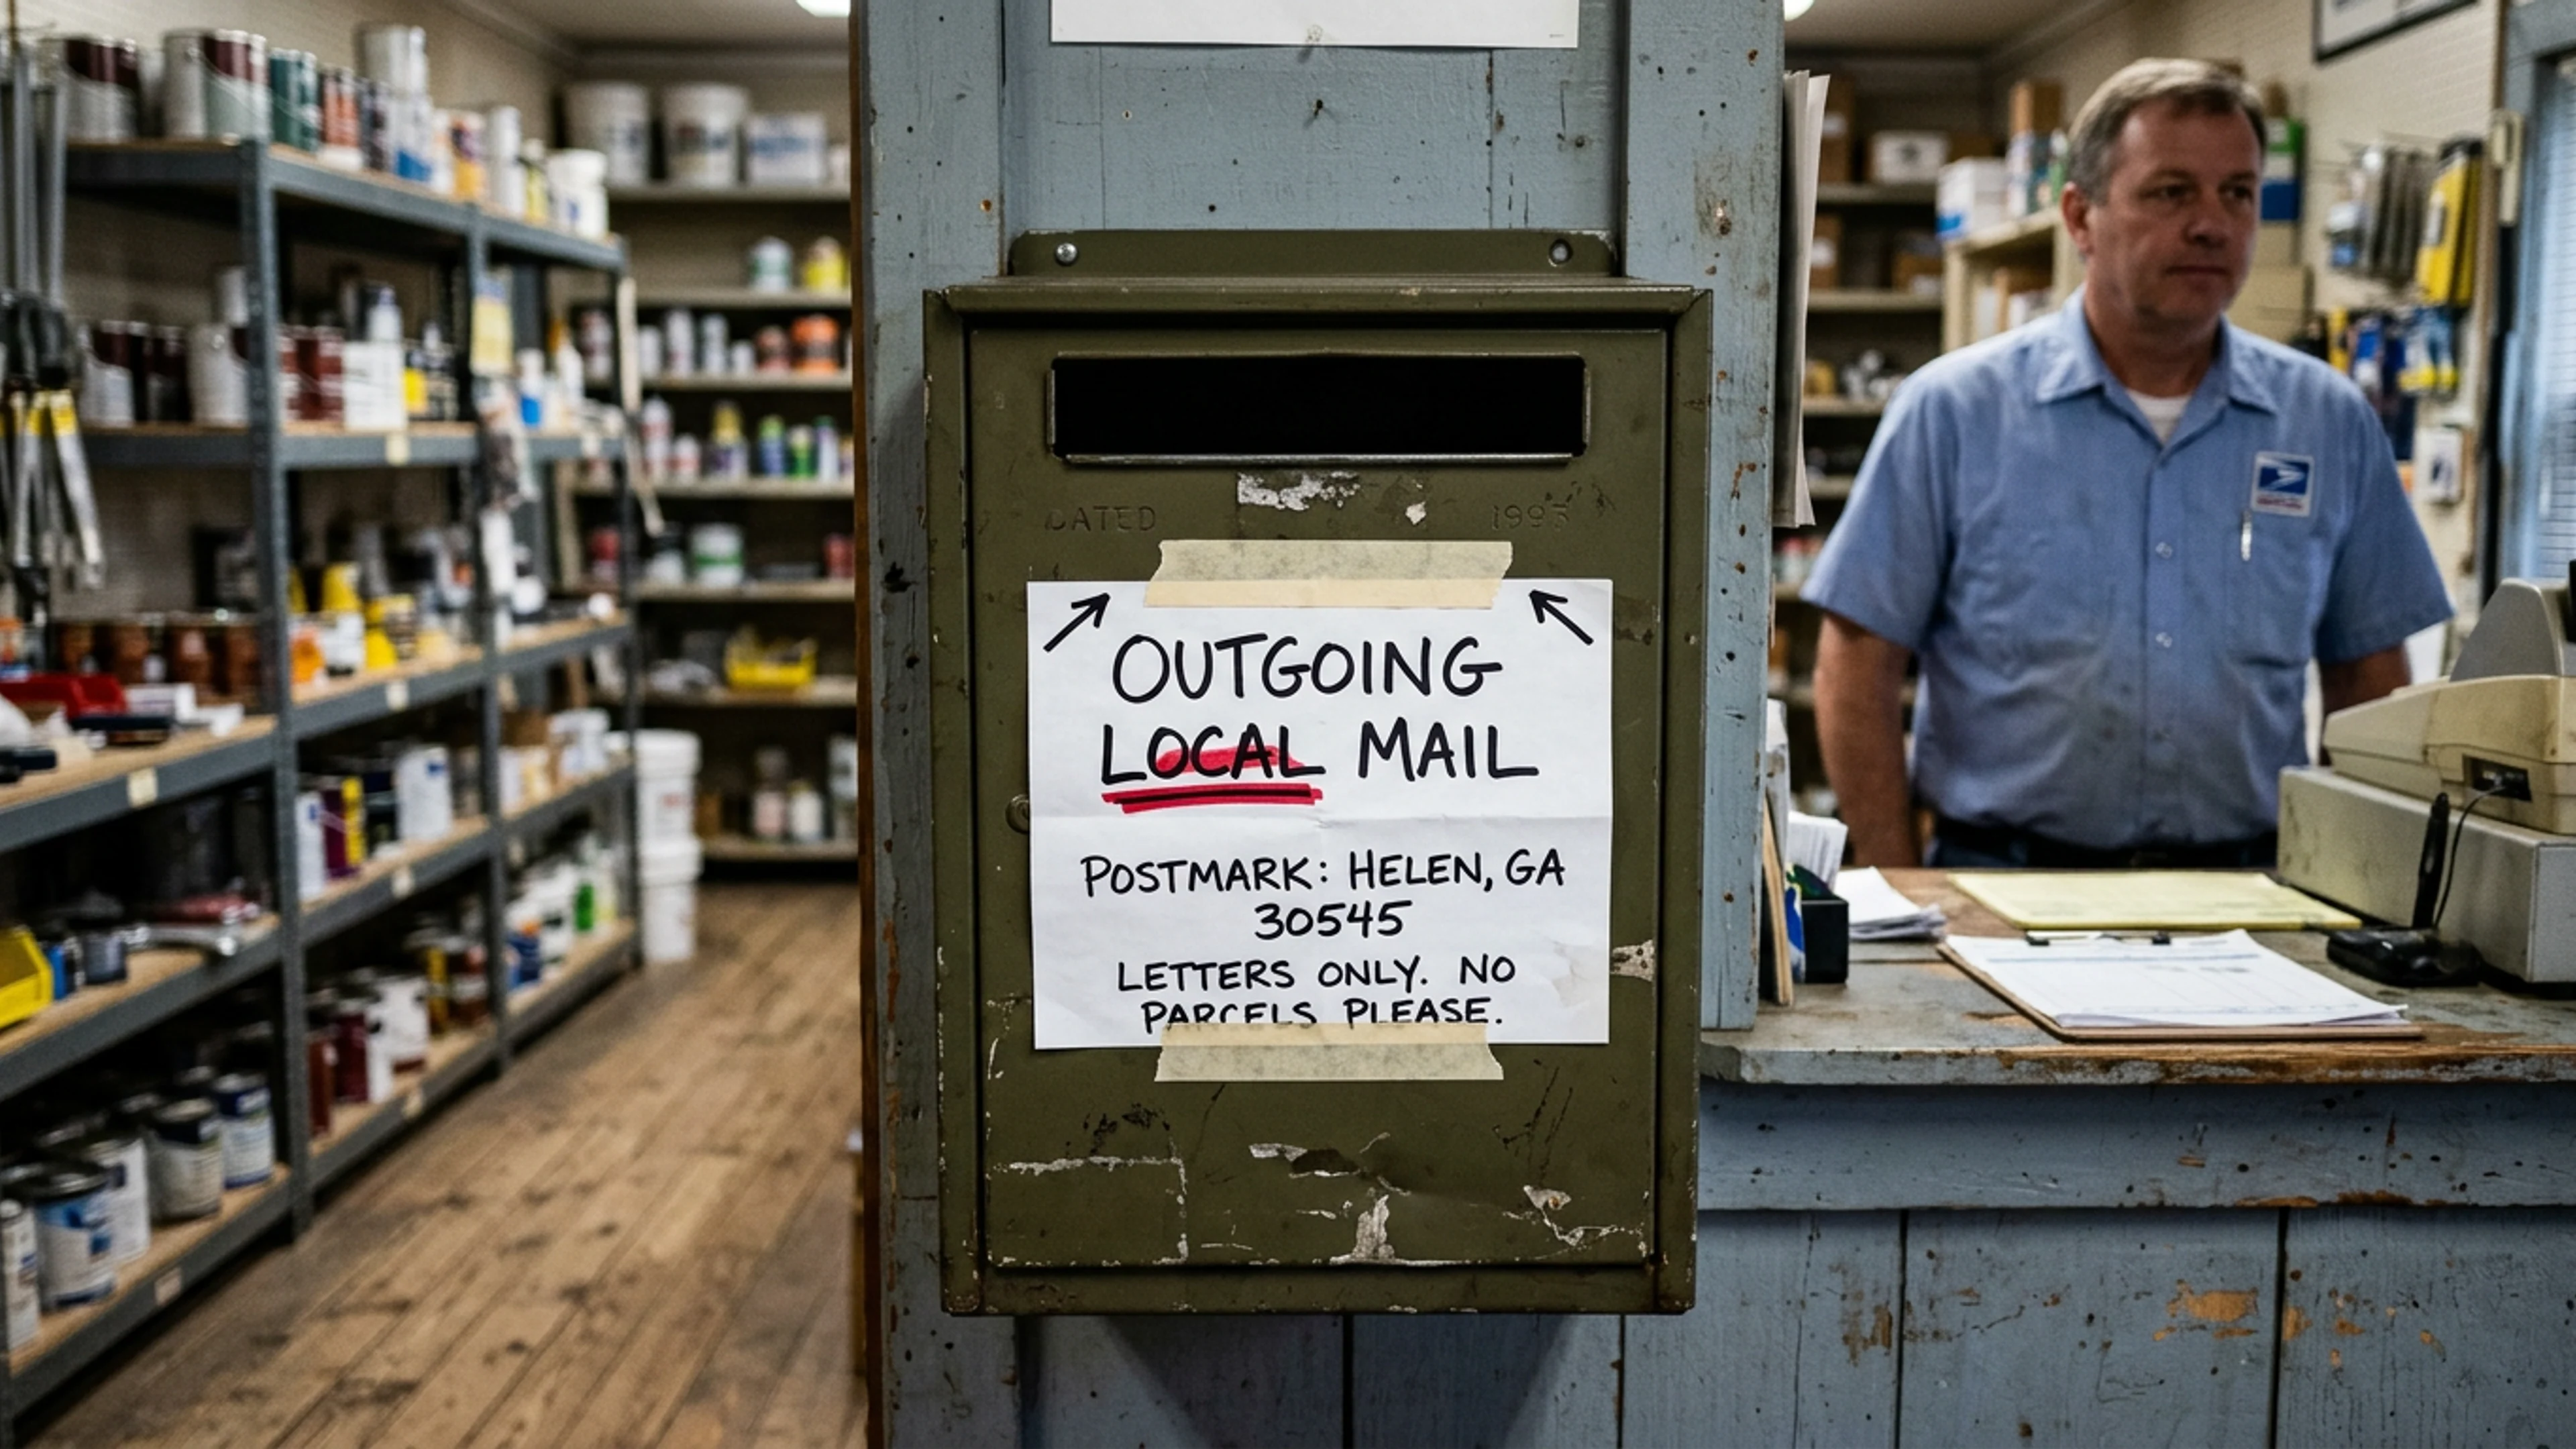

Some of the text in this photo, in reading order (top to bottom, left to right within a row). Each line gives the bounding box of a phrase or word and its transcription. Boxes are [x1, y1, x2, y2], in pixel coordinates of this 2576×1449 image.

[1113, 634, 1502, 703] OUTGOING
[1102, 717, 1539, 784] LOCAL MAIL
[1081, 849, 1564, 897] POSTMARK: HELEN, GA
[1255, 900, 1412, 940] 30545
[1119, 954, 1515, 993] LETTERS ONLY. NO
[1141, 998, 1501, 1034] PARCELS PLEASE.
